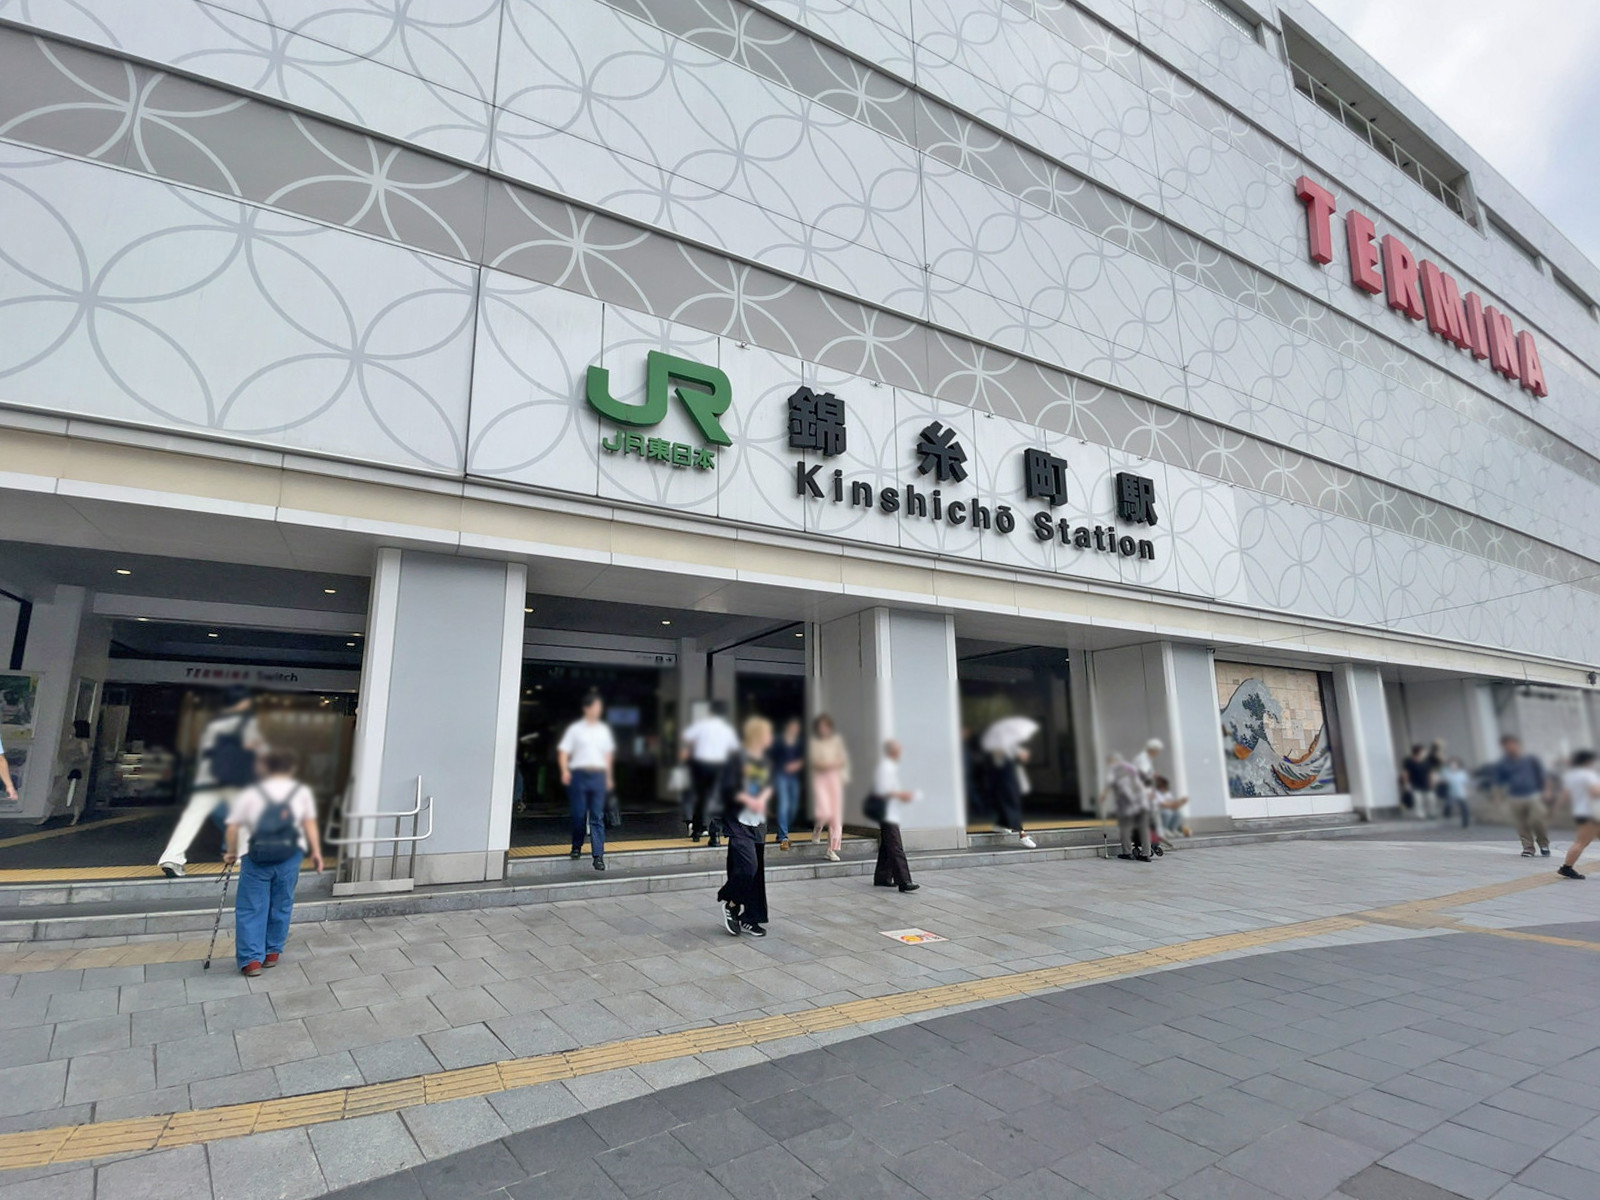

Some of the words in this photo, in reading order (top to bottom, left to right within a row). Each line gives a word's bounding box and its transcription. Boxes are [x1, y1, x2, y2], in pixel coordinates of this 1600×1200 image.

[1295, 175, 1548, 398] TERMINA
[586, 349, 733, 448] JR
[602, 429, 715, 471] JR東日本
[787, 385, 1158, 526] 錦糸町駅
[796, 460, 1015, 535] Kinshichō
[1033, 510, 1155, 561] Station
